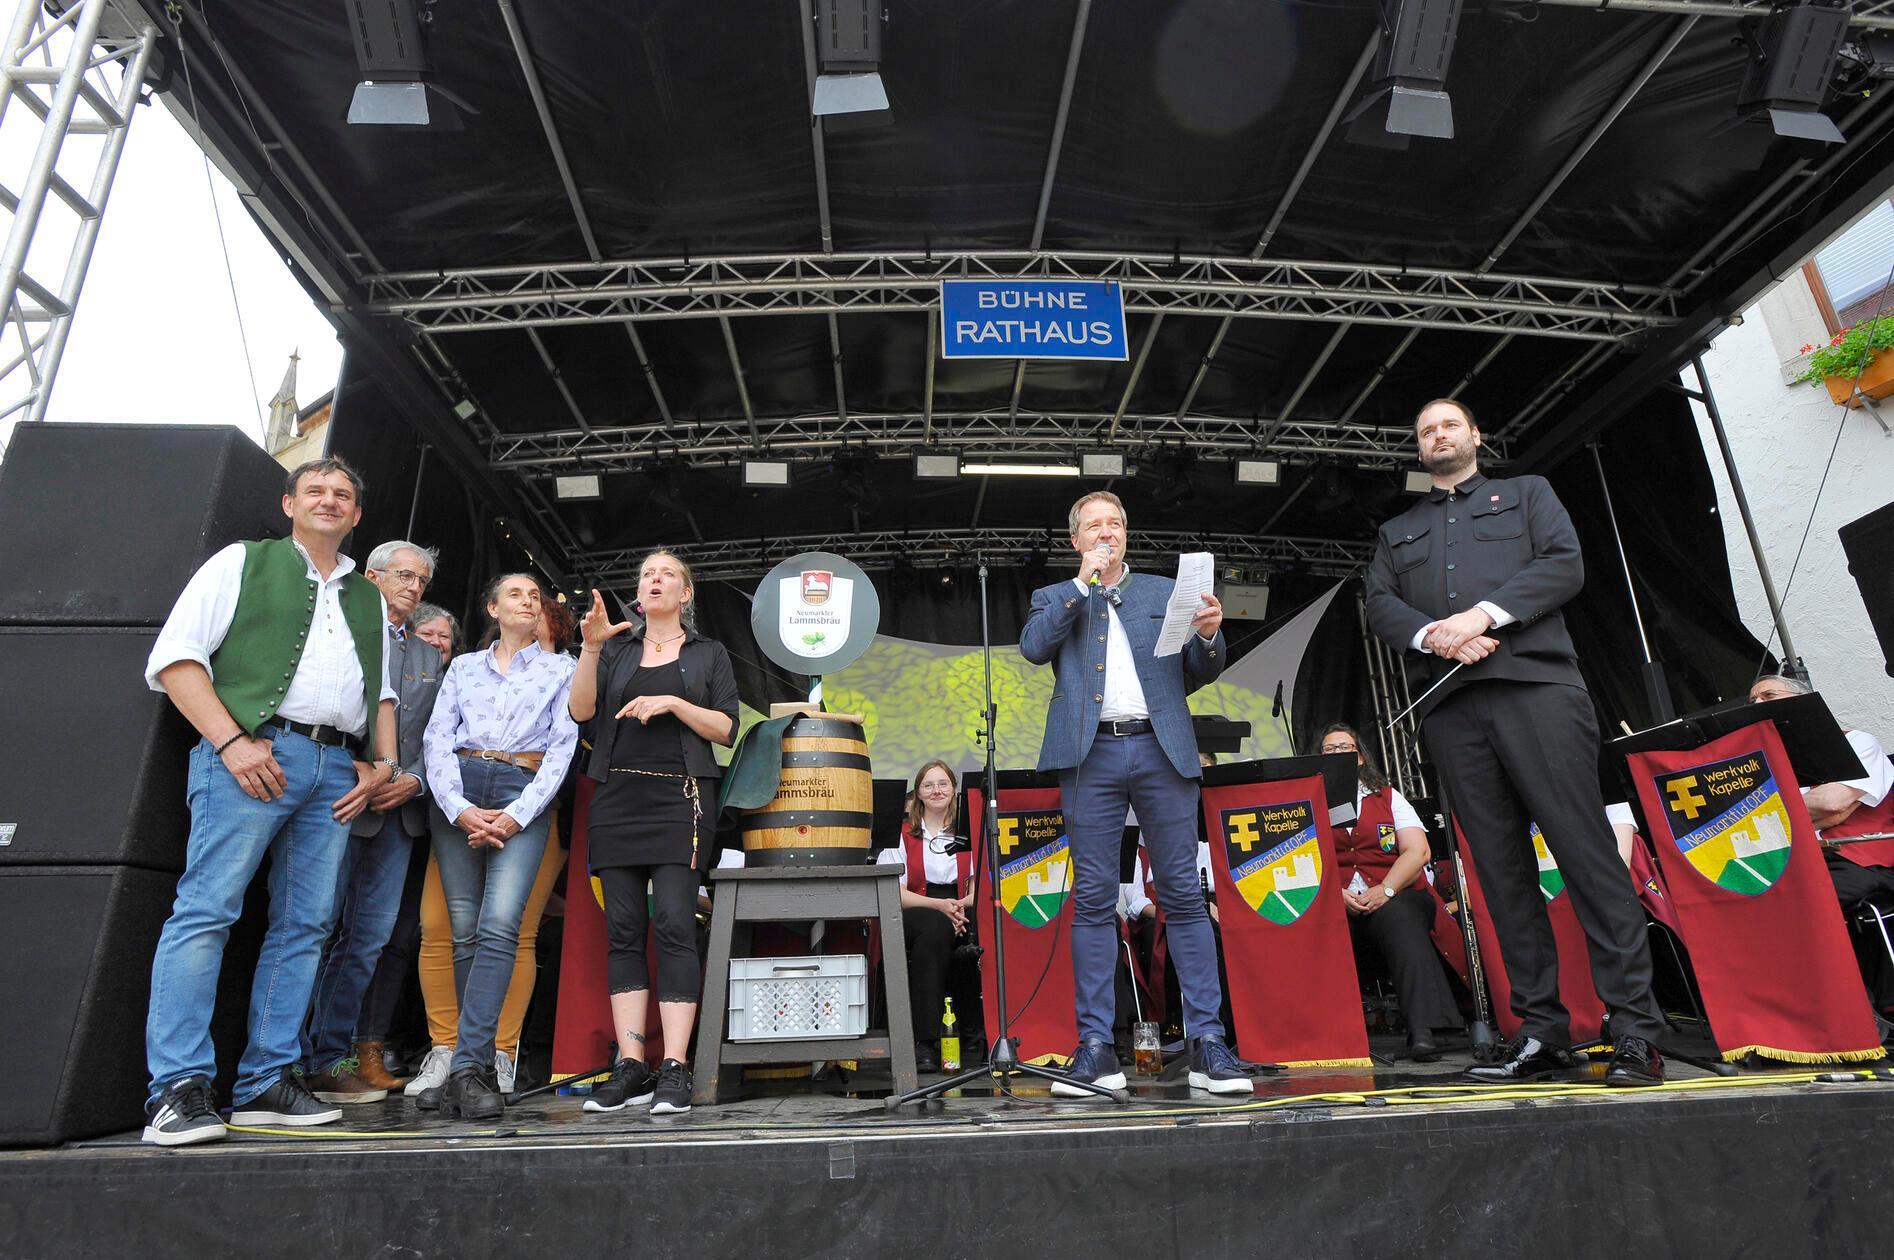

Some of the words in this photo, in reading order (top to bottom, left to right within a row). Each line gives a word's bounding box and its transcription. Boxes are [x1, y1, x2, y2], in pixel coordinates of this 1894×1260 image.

[978, 290, 1088, 309] BÜHNE
[956, 320, 1113, 345] RATHAUS
[789, 616, 841, 625] Lammsbräu
[774, 786, 835, 799] ammsbräu
[1707, 777, 1754, 796] Kapelle
[1261, 805, 1307, 821] Werkvolk
[1025, 827, 1057, 840] Kapelle
[1264, 820, 1299, 834] Kapelle
[1684, 812, 1738, 847] Neumarkt
[1236, 850, 1282, 877] Neumarkt
